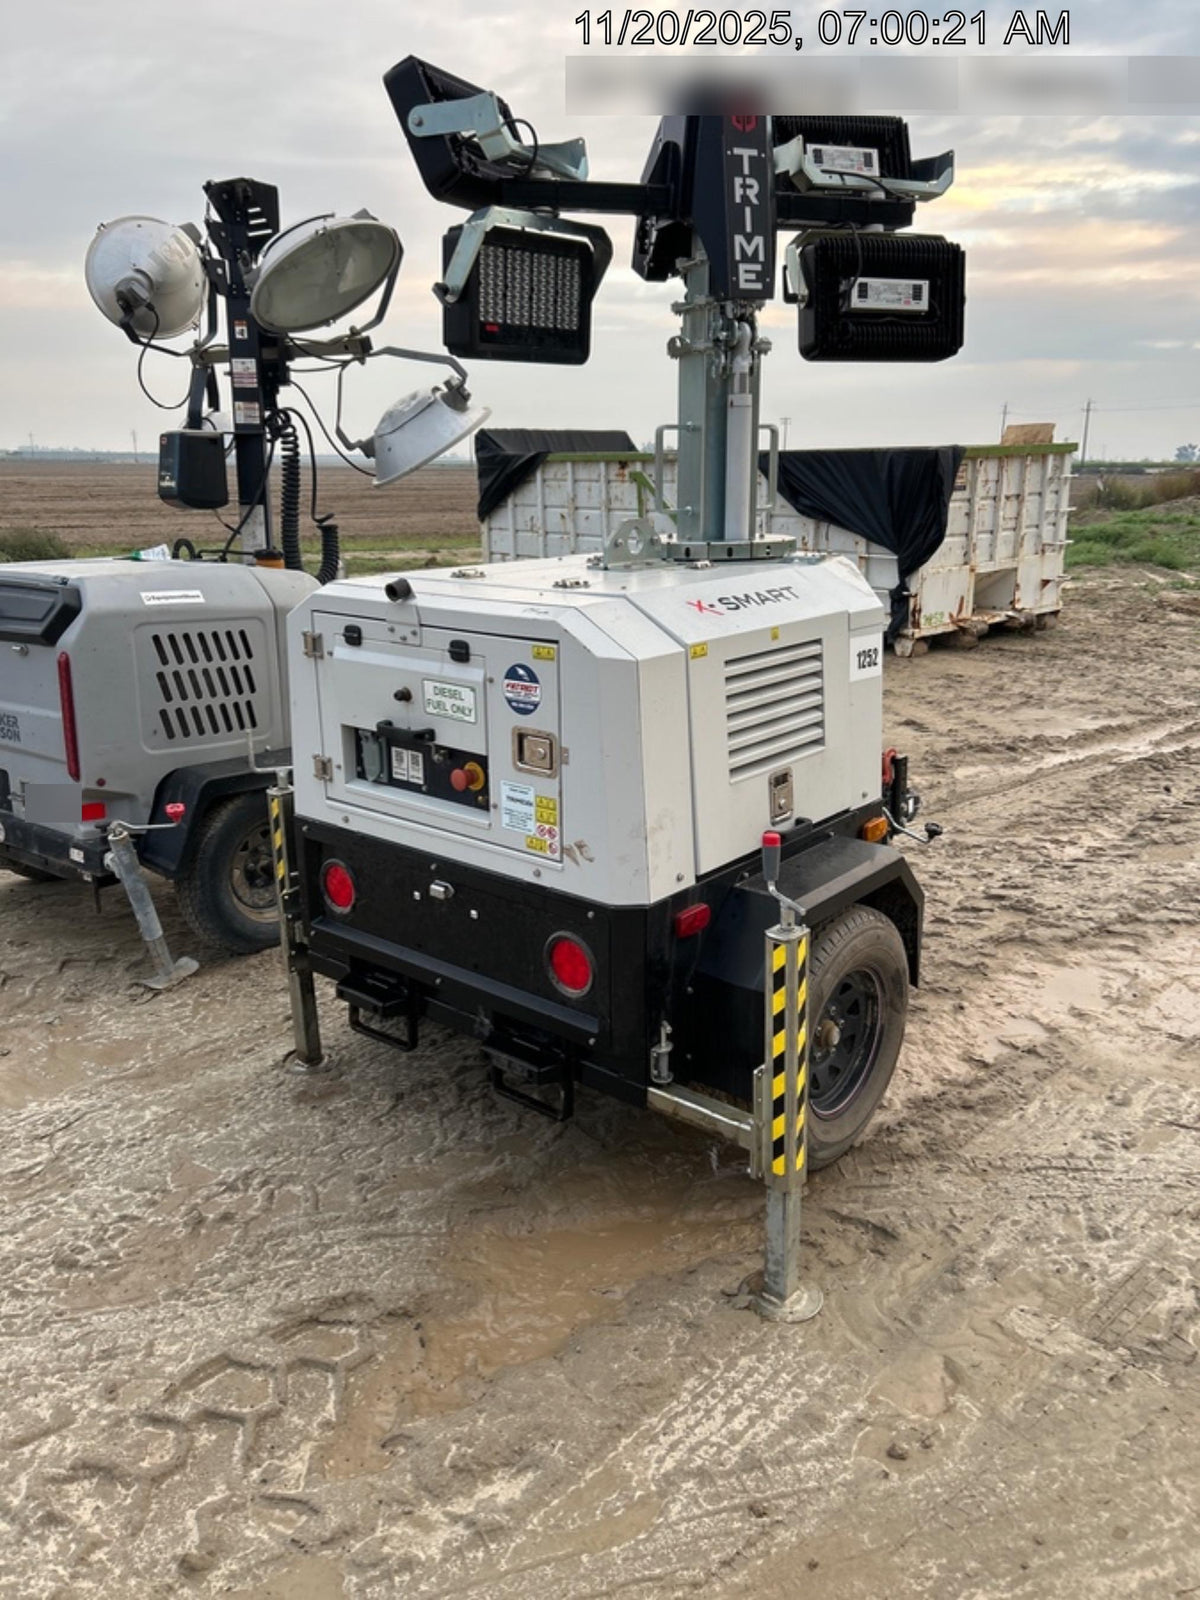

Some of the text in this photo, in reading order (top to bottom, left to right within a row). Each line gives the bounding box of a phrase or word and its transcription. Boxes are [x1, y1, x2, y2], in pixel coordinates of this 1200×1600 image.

[733, 147, 765, 290] TRIME
[856, 647, 879, 669] 1252
[433, 686, 465, 701] DIESEL
[426, 698, 449, 711] FUEL
[451, 703, 473, 717] ONLY
